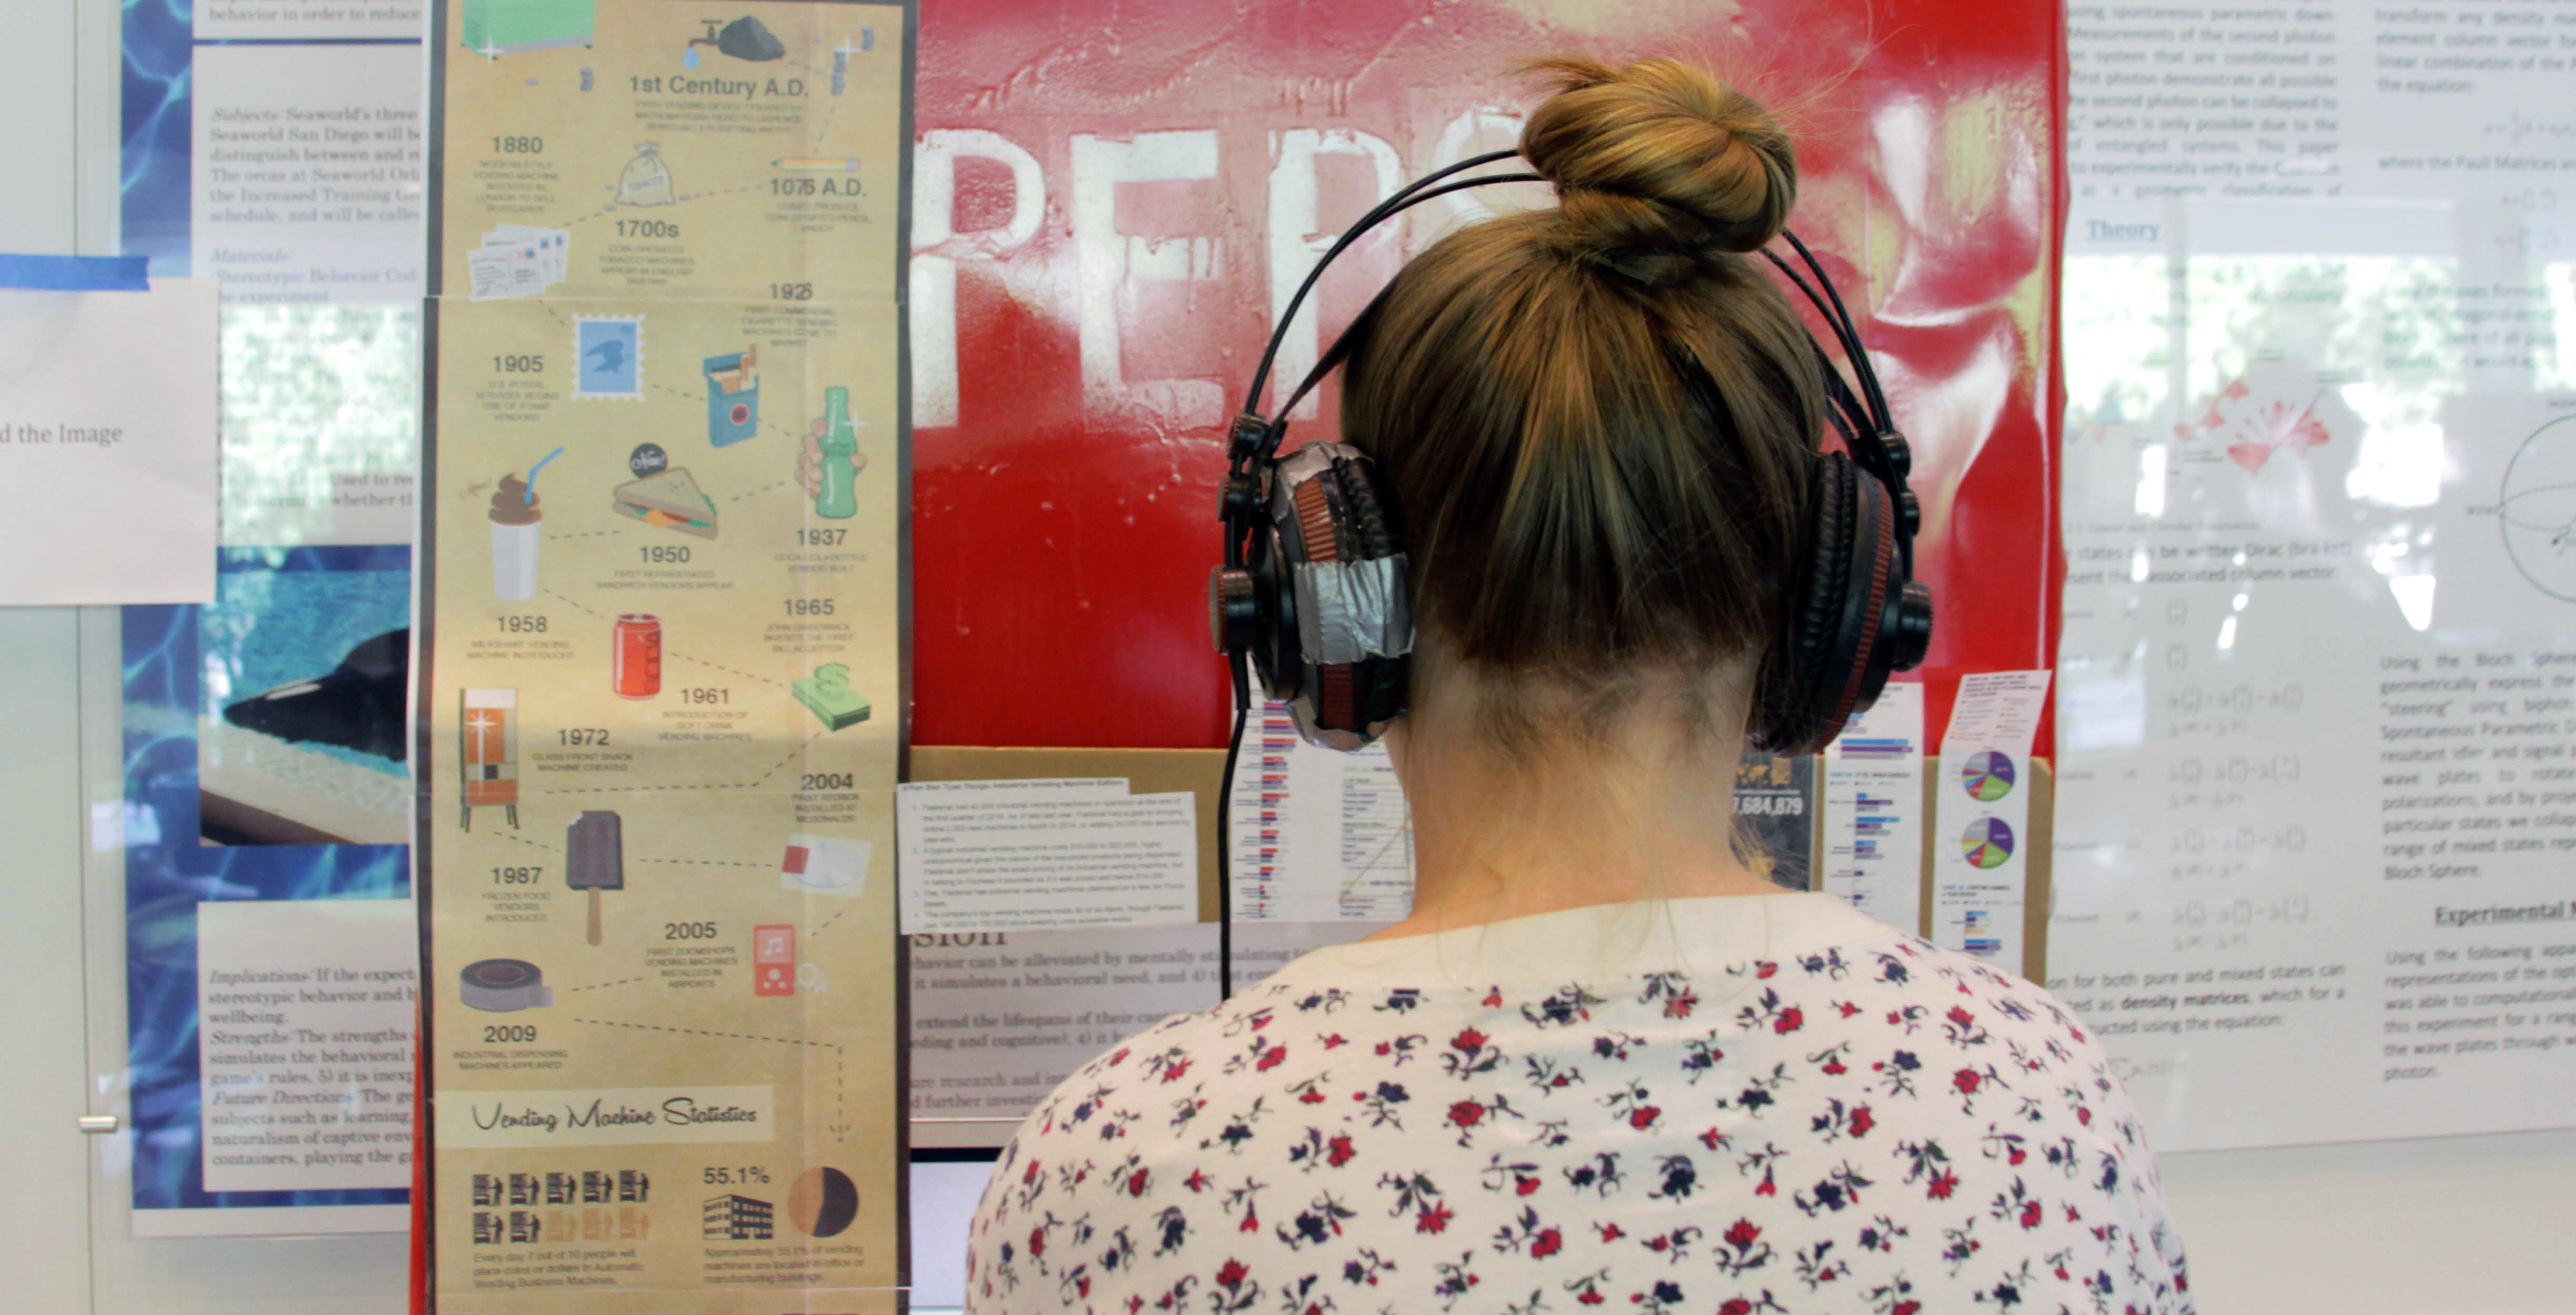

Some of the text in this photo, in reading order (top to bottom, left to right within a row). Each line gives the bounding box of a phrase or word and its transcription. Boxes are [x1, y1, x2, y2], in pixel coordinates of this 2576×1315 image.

[209, 6, 277, 21] behavior
[282, 6, 298, 21] in
[302, 6, 344, 21] order
[350, 7, 364, 20] to
[2179, 26, 2195, 42] of
[2200, 27, 2223, 42] the
[630, 75, 809, 100] 1st Century A.D.
[377, 106, 417, 121] three
[211, 126, 402, 143] Seaworld San Diego will
[492, 136, 543, 154] 1880
[211, 147, 403, 162] distinguish between and
[211, 167, 384, 182] The orcas at Seaworld
[210, 187, 391, 203] the Increased Training
[822, 177, 868, 197] A.D.
[288, 207, 317, 222] and
[322, 207, 351, 221] will
[356, 207, 374, 221] be
[616, 220, 680, 238] 1700s
[2087, 219, 2159, 241] Theory
[310, 267, 380, 283] Behavior
[493, 354, 544, 373] 1905
[17, 423, 53, 443] the
[58, 423, 124, 448] Image
[796, 528, 847, 546] 1937
[640, 546, 691, 564] 1950
[783, 598, 835, 616] 1965
[497, 615, 547, 633] 1958
[681, 687, 729, 705] 1961
[558, 728, 610, 747] 1972
[801, 773, 854, 791] 2004
[491, 866, 543, 884] 1987
[2435, 901, 2565, 927] Experimental
[665, 921, 717, 940] 2005
[1001, 953, 1019, 967] be
[1104, 950, 1121, 966] by
[316, 967, 330, 982] If
[334, 967, 358, 982] the
[1026, 970, 1108, 987] behavioral
[1159, 968, 1186, 983] and
[2102, 971, 2137, 987] both
[2185, 968, 2213, 983] and
[2219, 965, 2263, 981] mixed
[2269, 964, 2314, 979] states
[2319, 963, 2345, 977] can
[209, 987, 402, 1005] stereotypic behavior and
[2121, 994, 2176, 1011] density
[2260, 985, 2303, 1002] which
[973, 1013, 999, 1027] the
[1076, 1011, 1092, 1025] of
[2144, 1019, 2182, 1035] using
[2186, 1015, 2209, 1031] the
[297, 1027, 407, 1045] The strengths
[483, 1025, 537, 1043] 2009
[959, 1033, 987, 1047] and
[210, 1048, 405, 1064] simulates the behavioral
[338, 1069, 351, 1083] it
[354, 1068, 369, 1083] is
[1011, 1071, 1041, 1085] and
[360, 1088, 391, 1103] The
[280, 1110, 316, 1124] such
[320, 1112, 338, 1124] as
[472, 1097, 758, 1133] Vending Machine Statistics
[211, 1130, 381, 1147] naturalism of captive
[303, 1149, 363, 1167] playing
[368, 1148, 393, 1163] the
[703, 1166, 771, 1185] 55.1%
